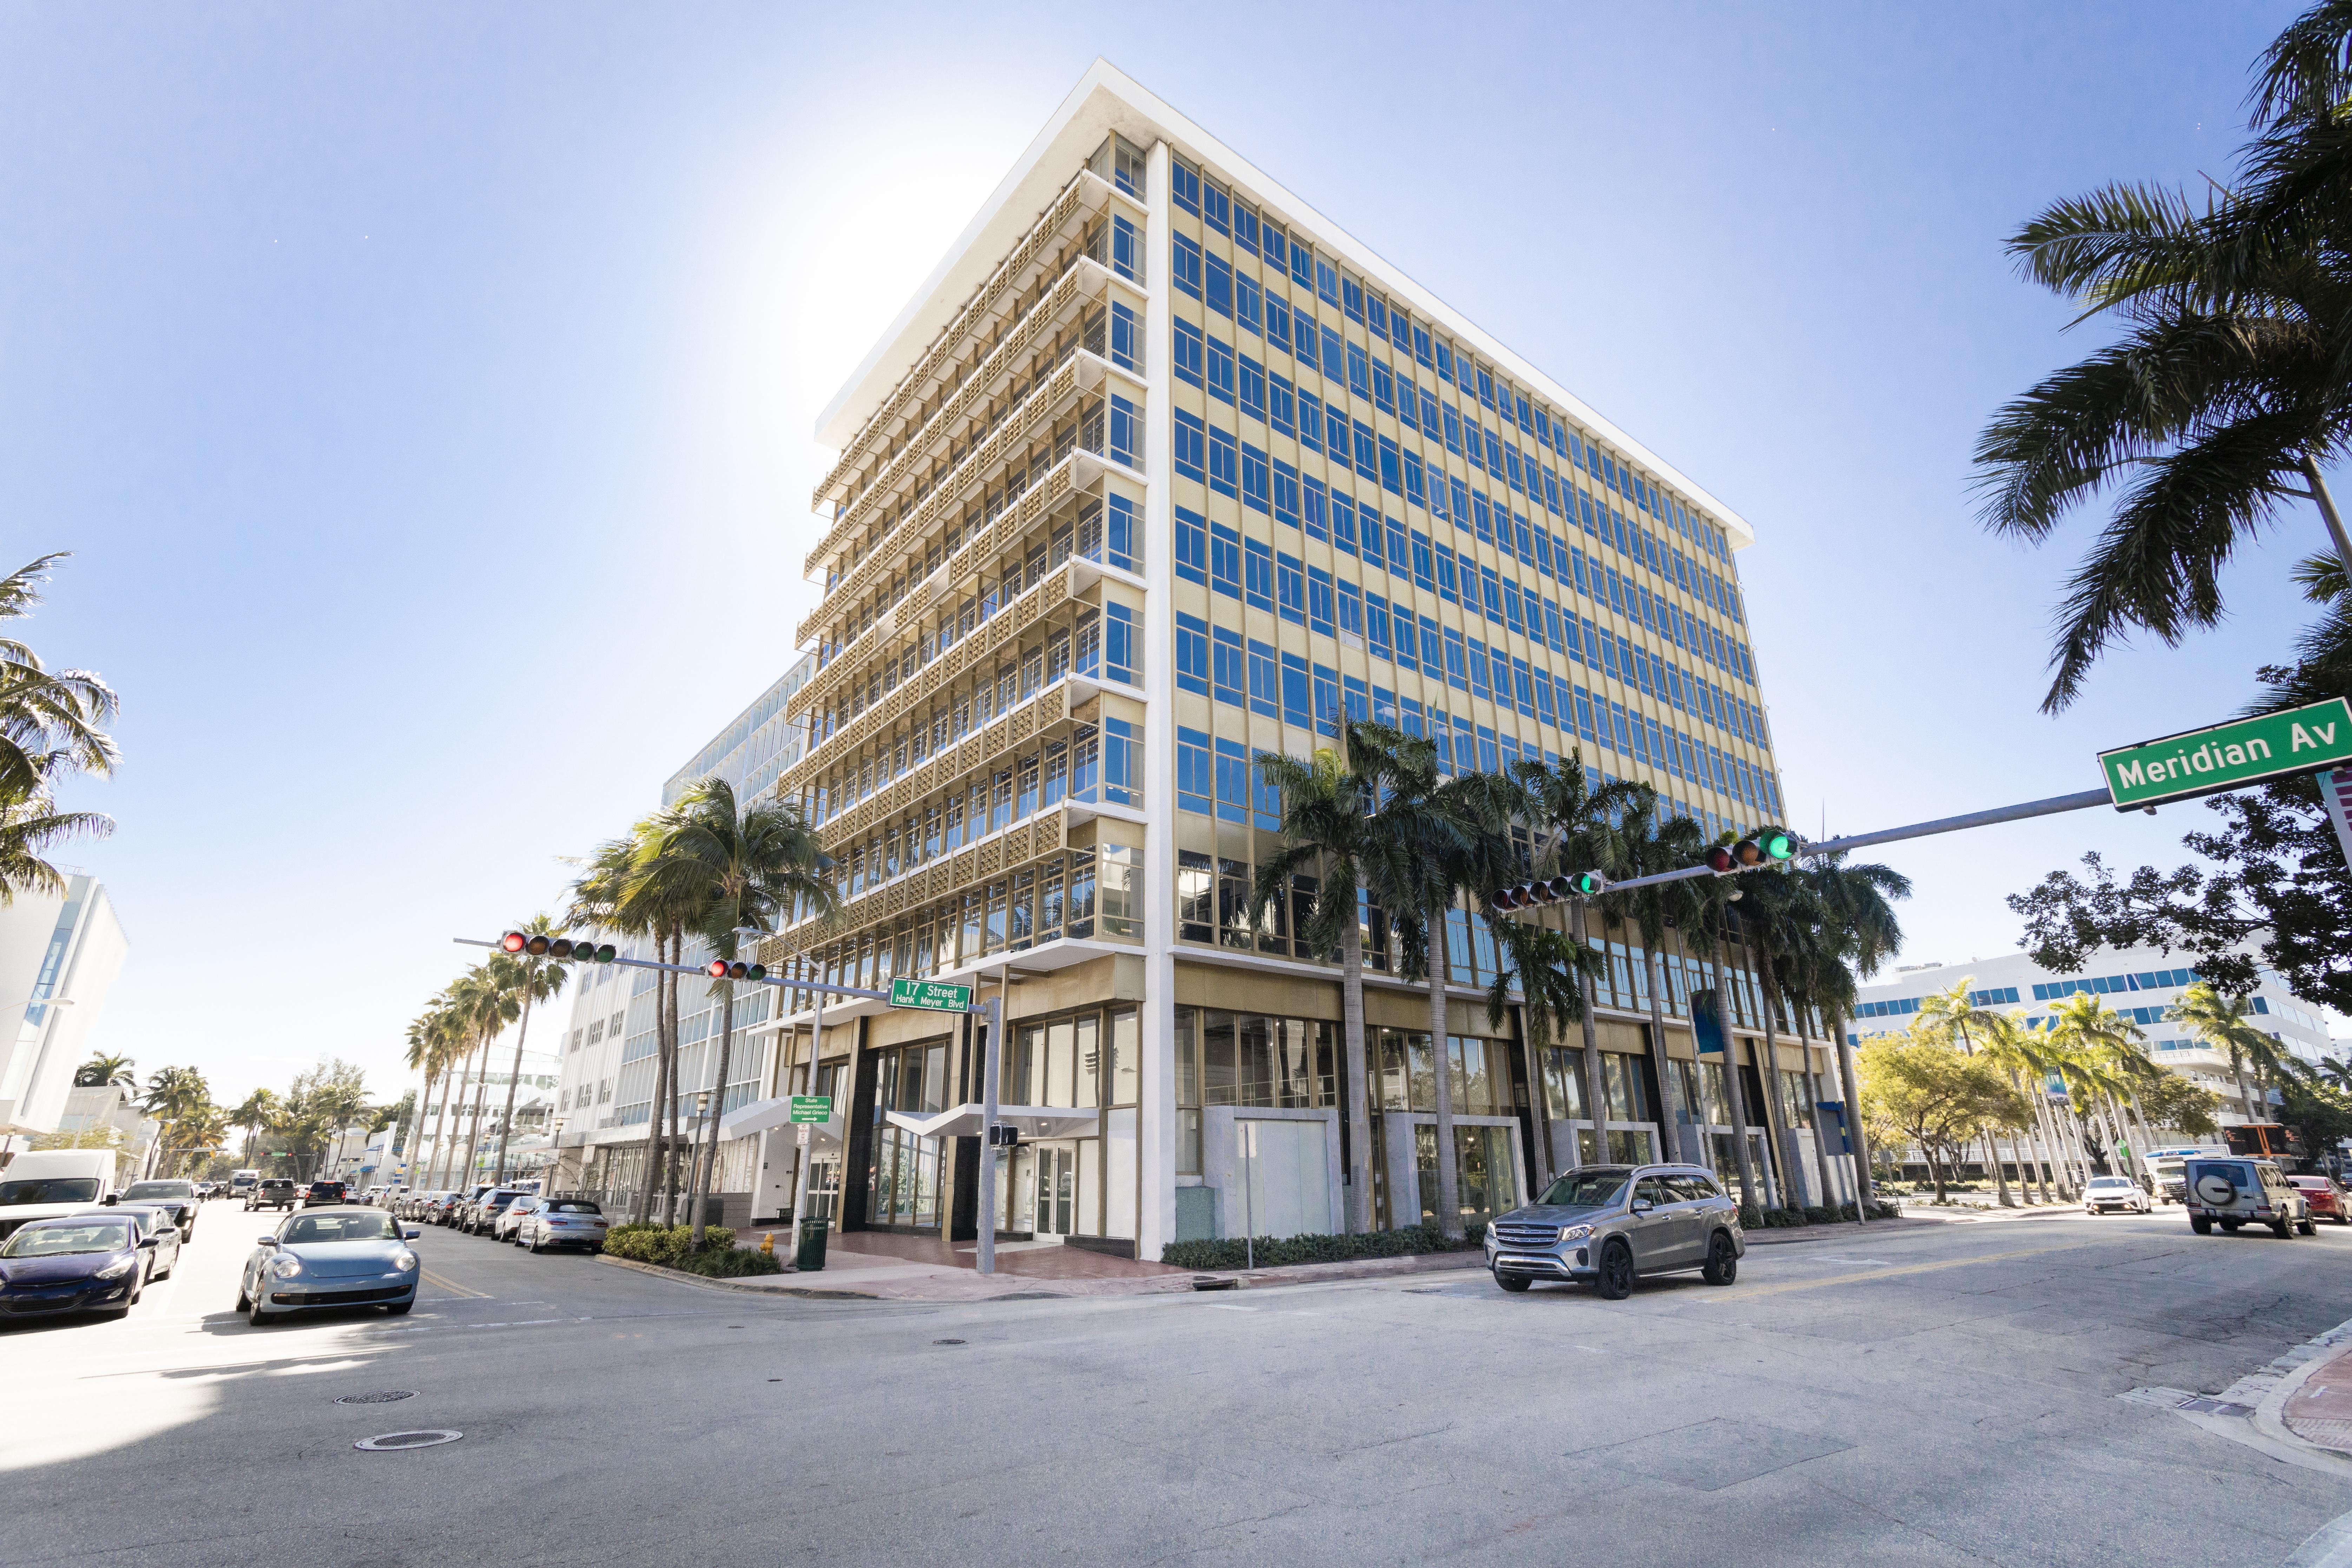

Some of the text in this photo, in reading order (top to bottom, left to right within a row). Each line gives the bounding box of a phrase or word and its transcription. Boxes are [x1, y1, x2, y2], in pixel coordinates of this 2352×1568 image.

[2116, 722, 2335, 789] Meridian Av
[906, 982, 957, 999] 17 Street
[896, 994, 964, 1008] Hank Meyer Blvd
